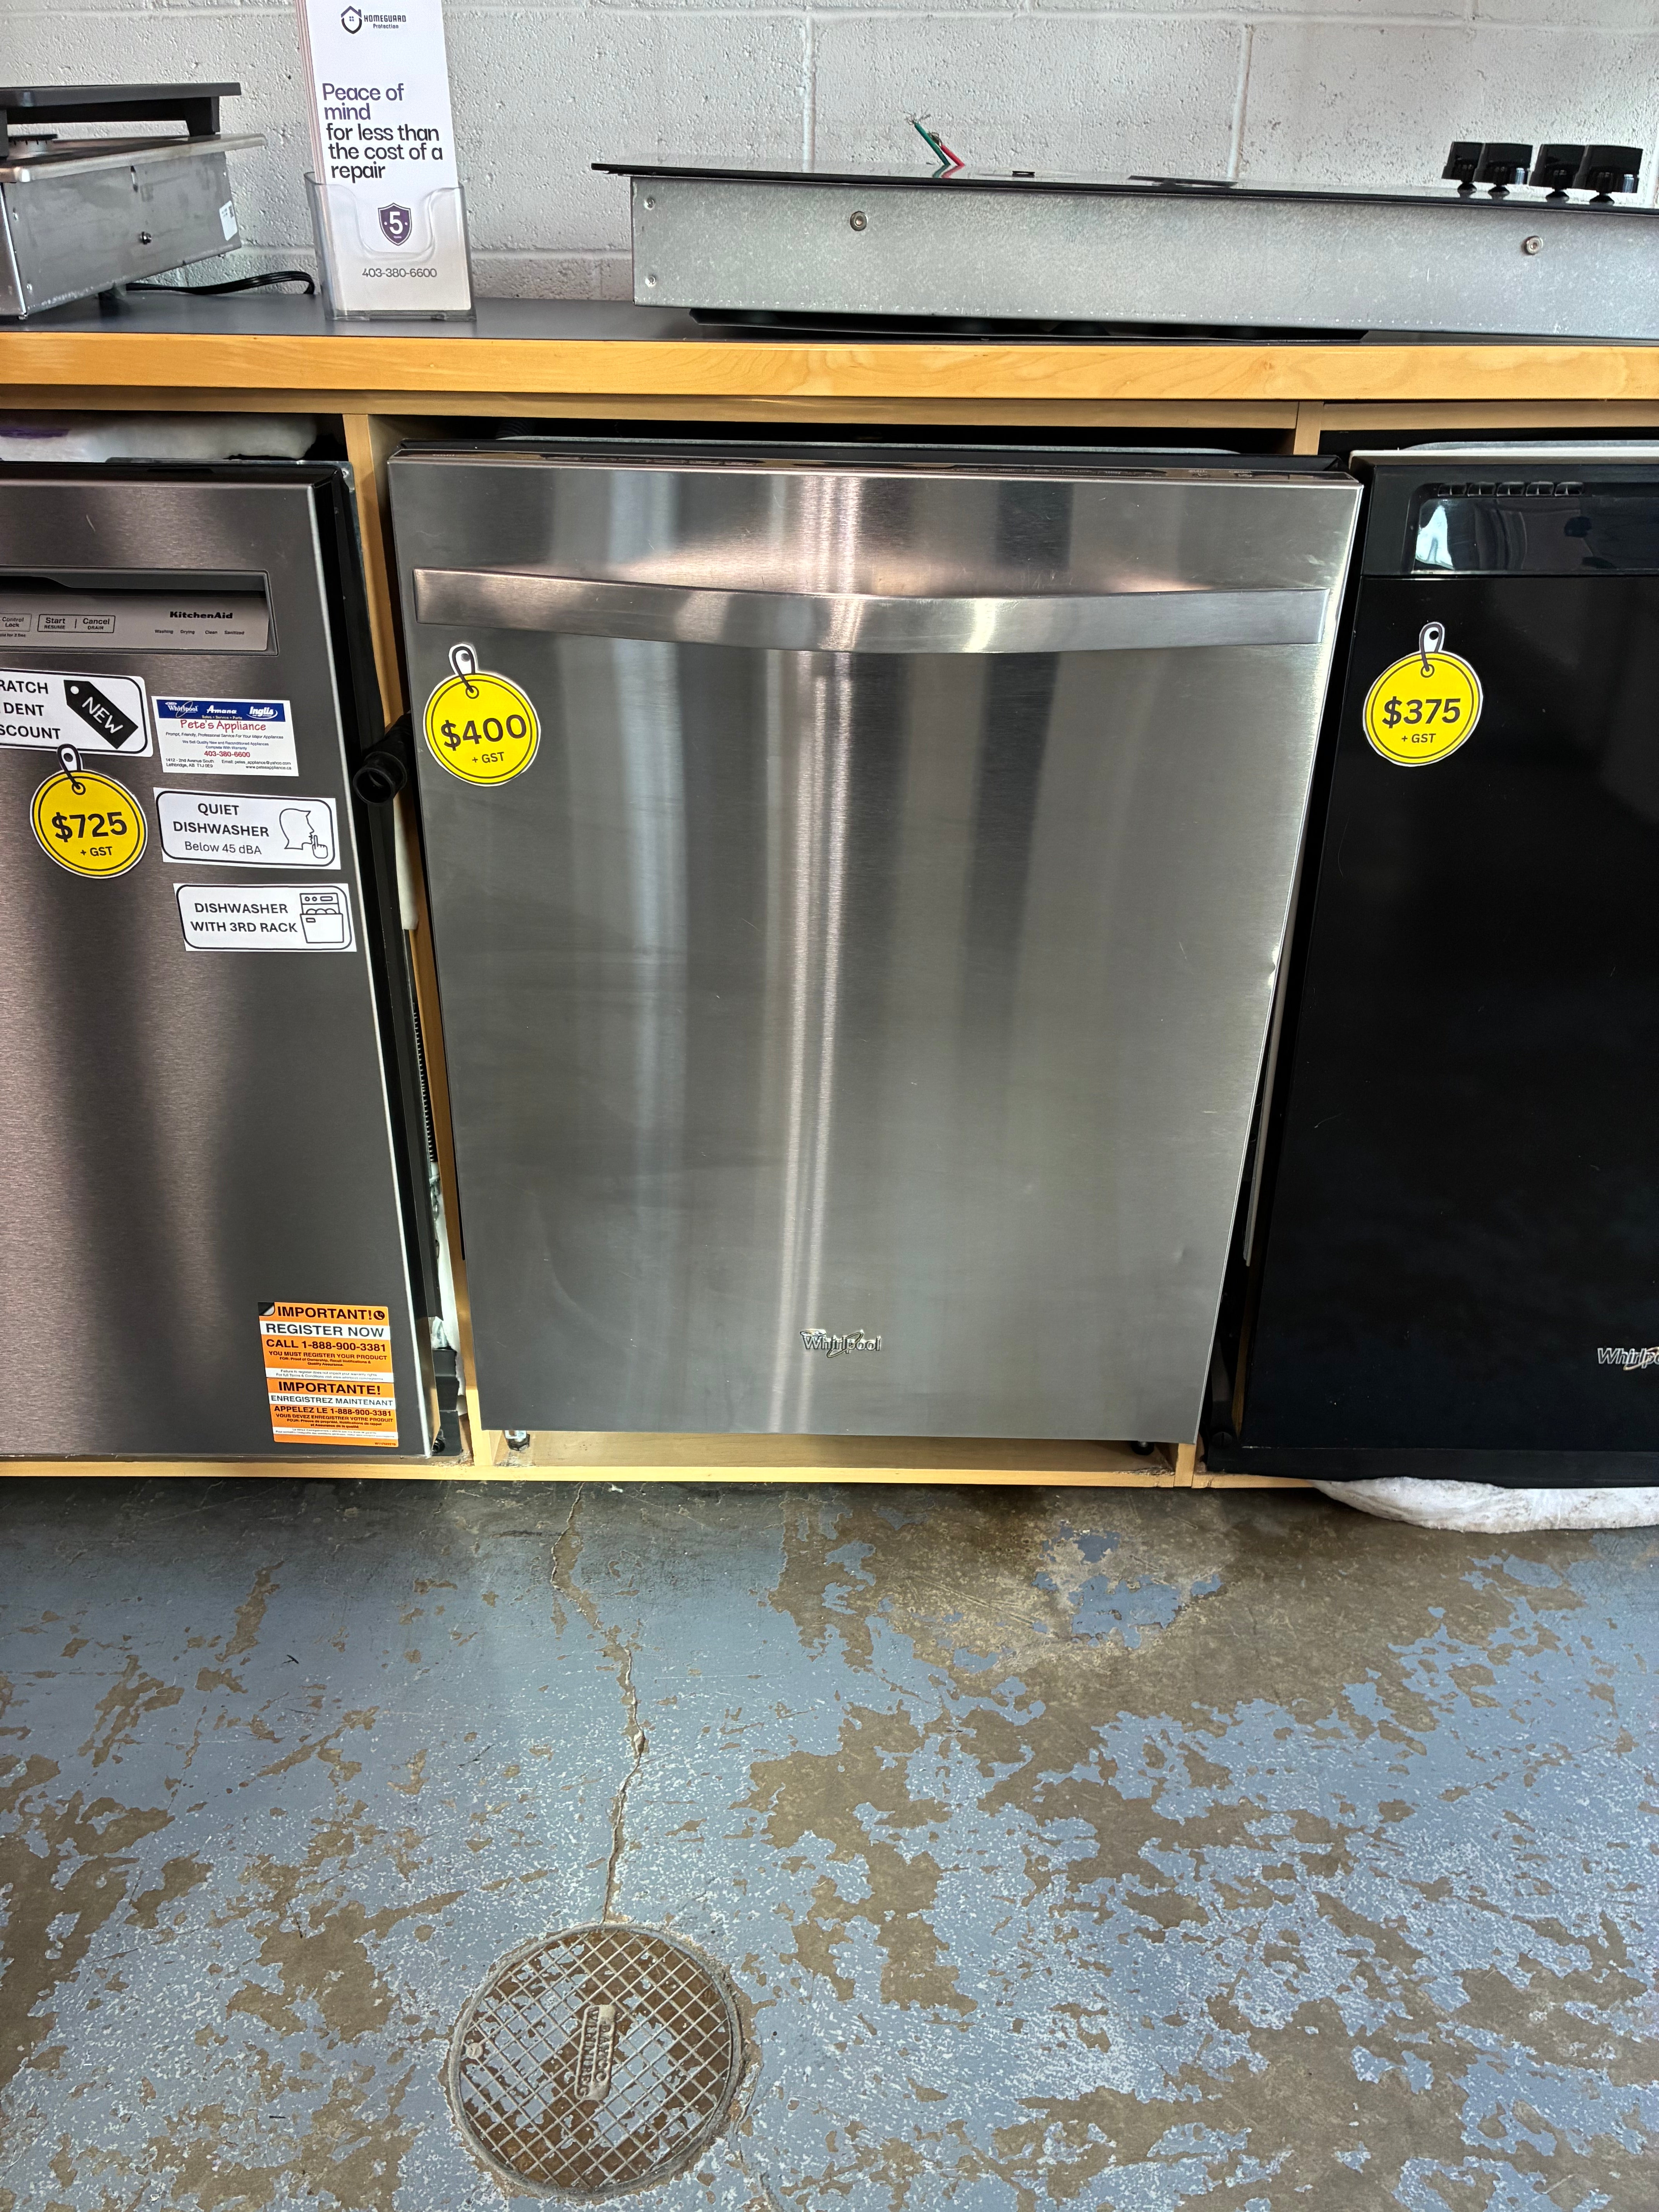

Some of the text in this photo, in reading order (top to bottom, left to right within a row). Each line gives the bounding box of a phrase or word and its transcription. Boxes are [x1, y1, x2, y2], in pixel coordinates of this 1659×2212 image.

[322, 83, 404, 101] Peace of
[324, 102, 371, 120] mind
[326, 123, 440, 141] for less than
[328, 142, 443, 160] the cost of a
[331, 161, 386, 184] repair
[389, 211, 403, 235] 5
[362, 268, 437, 278] 403-380-6600
[3, 702, 44, 716] DENT
[82, 696, 123, 734] NEW
[167, 704, 274, 716] Whirlpool Amana Inglis
[1382, 696, 1461, 729] $375
[180, 720, 266, 733] Pete's Appliance
[440, 714, 527, 752] $400
[1411, 733, 1436, 744] GST
[481, 751, 505, 764] GST
[198, 802, 239, 816] QUIET
[51, 811, 127, 843] $725
[173, 821, 270, 837] DISHWASHER
[90, 846, 113, 857] GST
[184, 841, 262, 855] Below 45 dBA
[194, 902, 288, 914] DISHWASHER
[190, 921, 298, 933] WITH 3RD RACK
[277, 1306, 372, 1320] IMPORTANT!
[266, 1323, 384, 1337] REGISTER NOW
[266, 1339, 386, 1352] CALL 1-888-900-3381
[802, 1335, 881, 1355] Whirlpool
[278, 1381, 381, 1395] IMPORTANTE!
[271, 1395, 333, 1403] ENREGISTREZ
[330, 1408, 391, 1416] 1-888-900-3381
